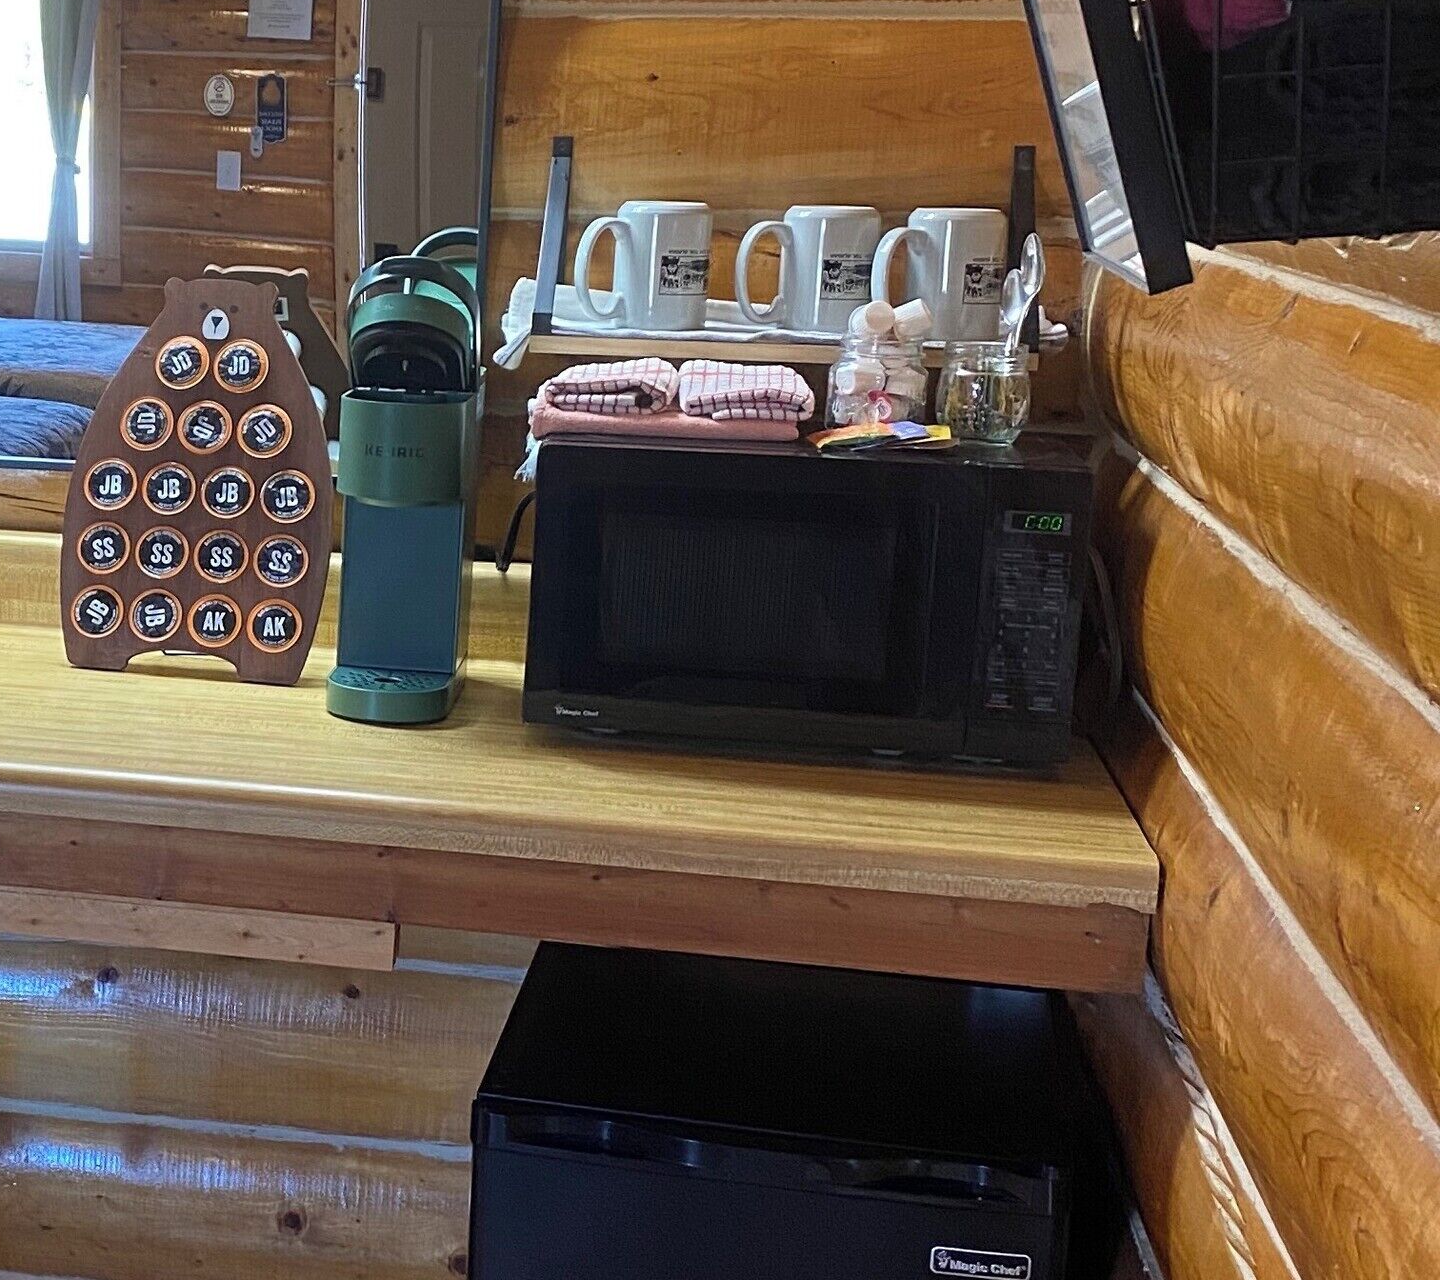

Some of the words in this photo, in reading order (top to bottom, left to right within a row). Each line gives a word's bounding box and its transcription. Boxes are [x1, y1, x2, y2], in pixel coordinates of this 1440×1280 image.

[171, 351, 193, 375] JD
[228, 355, 250, 376] JD
[253, 418, 276, 443] JD
[100, 474, 122, 495] JB
[157, 478, 180, 500] JB
[215, 482, 239, 504] JB
[275, 486, 299, 508] JB
[92, 536, 115, 560] SS
[150, 542, 174, 565] SS
[210, 546, 233, 568] SS
[268, 550, 293, 574] SS
[86, 599, 109, 625] JB
[144, 604, 166, 627] JB
[203, 611, 227, 632] AK
[263, 616, 286, 637] AK
[950, 1259, 988, 1274] Magic
[990, 1264, 1022, 1276] Chef
